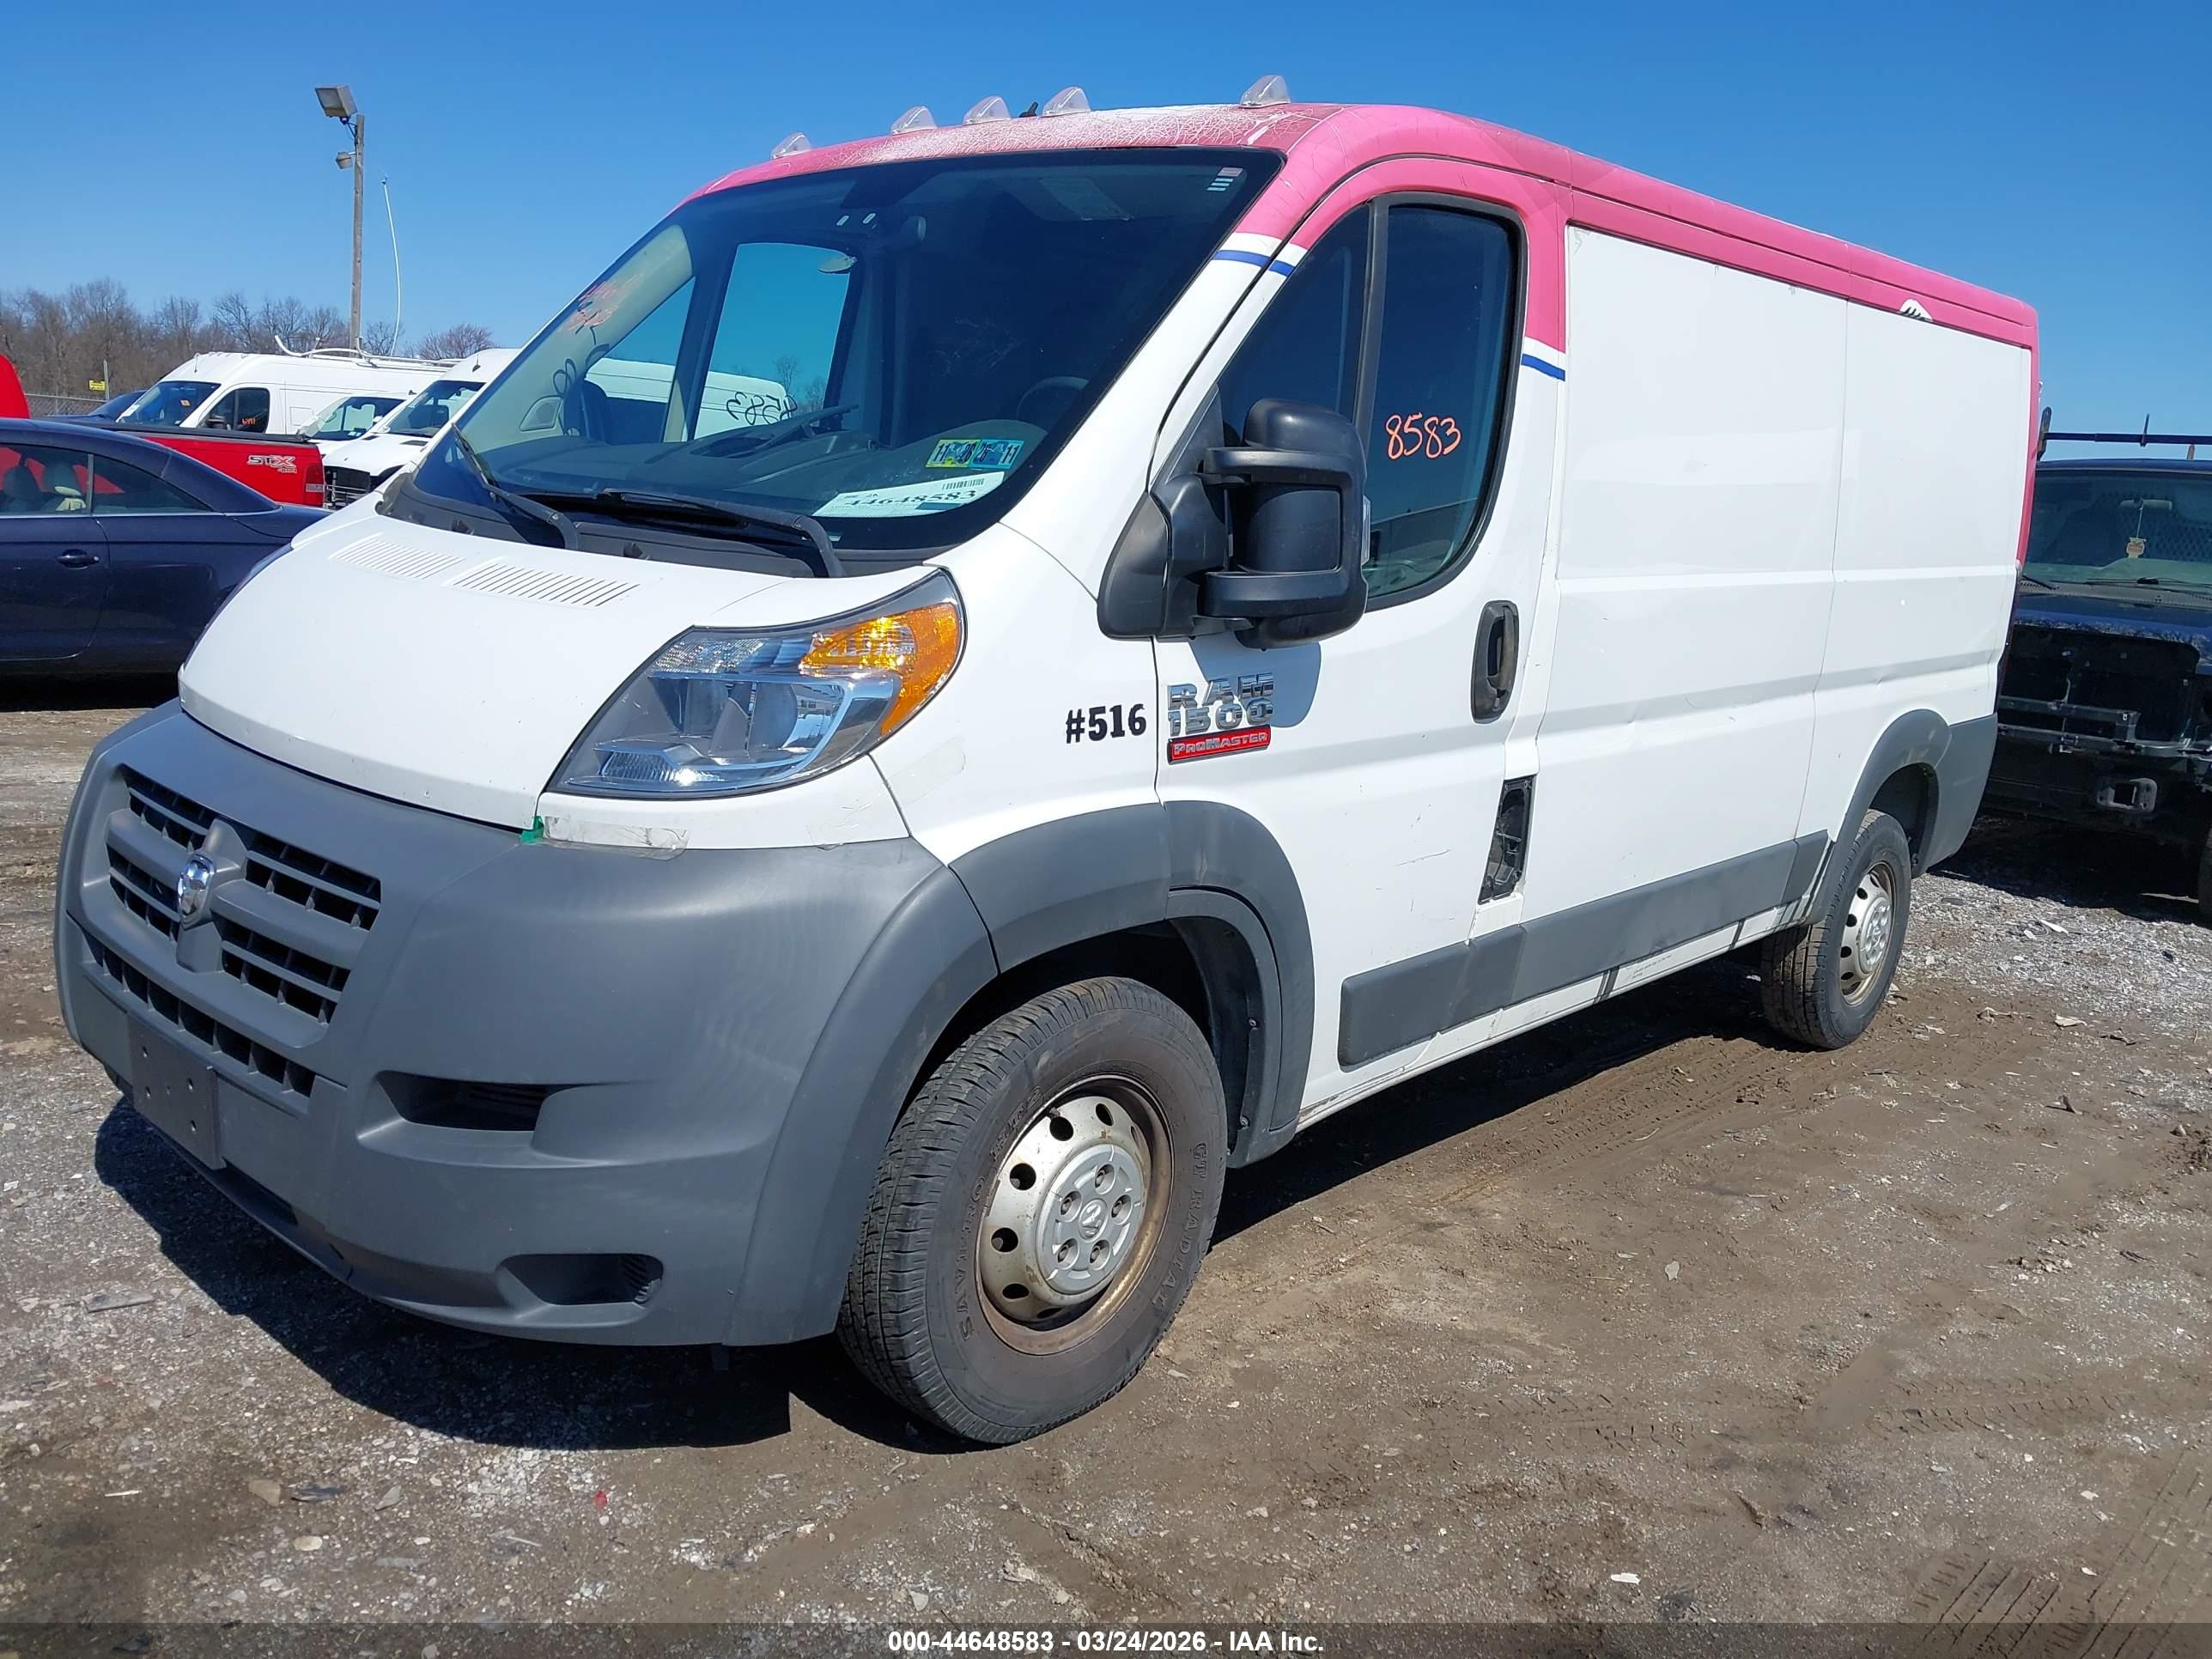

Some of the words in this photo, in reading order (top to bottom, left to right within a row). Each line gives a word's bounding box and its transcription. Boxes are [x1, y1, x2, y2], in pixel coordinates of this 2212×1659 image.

[1385, 412, 1462, 459] 8583
[1167, 673, 1274, 710] RAM
[1066, 703, 1147, 744] #516
[1168, 698, 1274, 737] 1500
